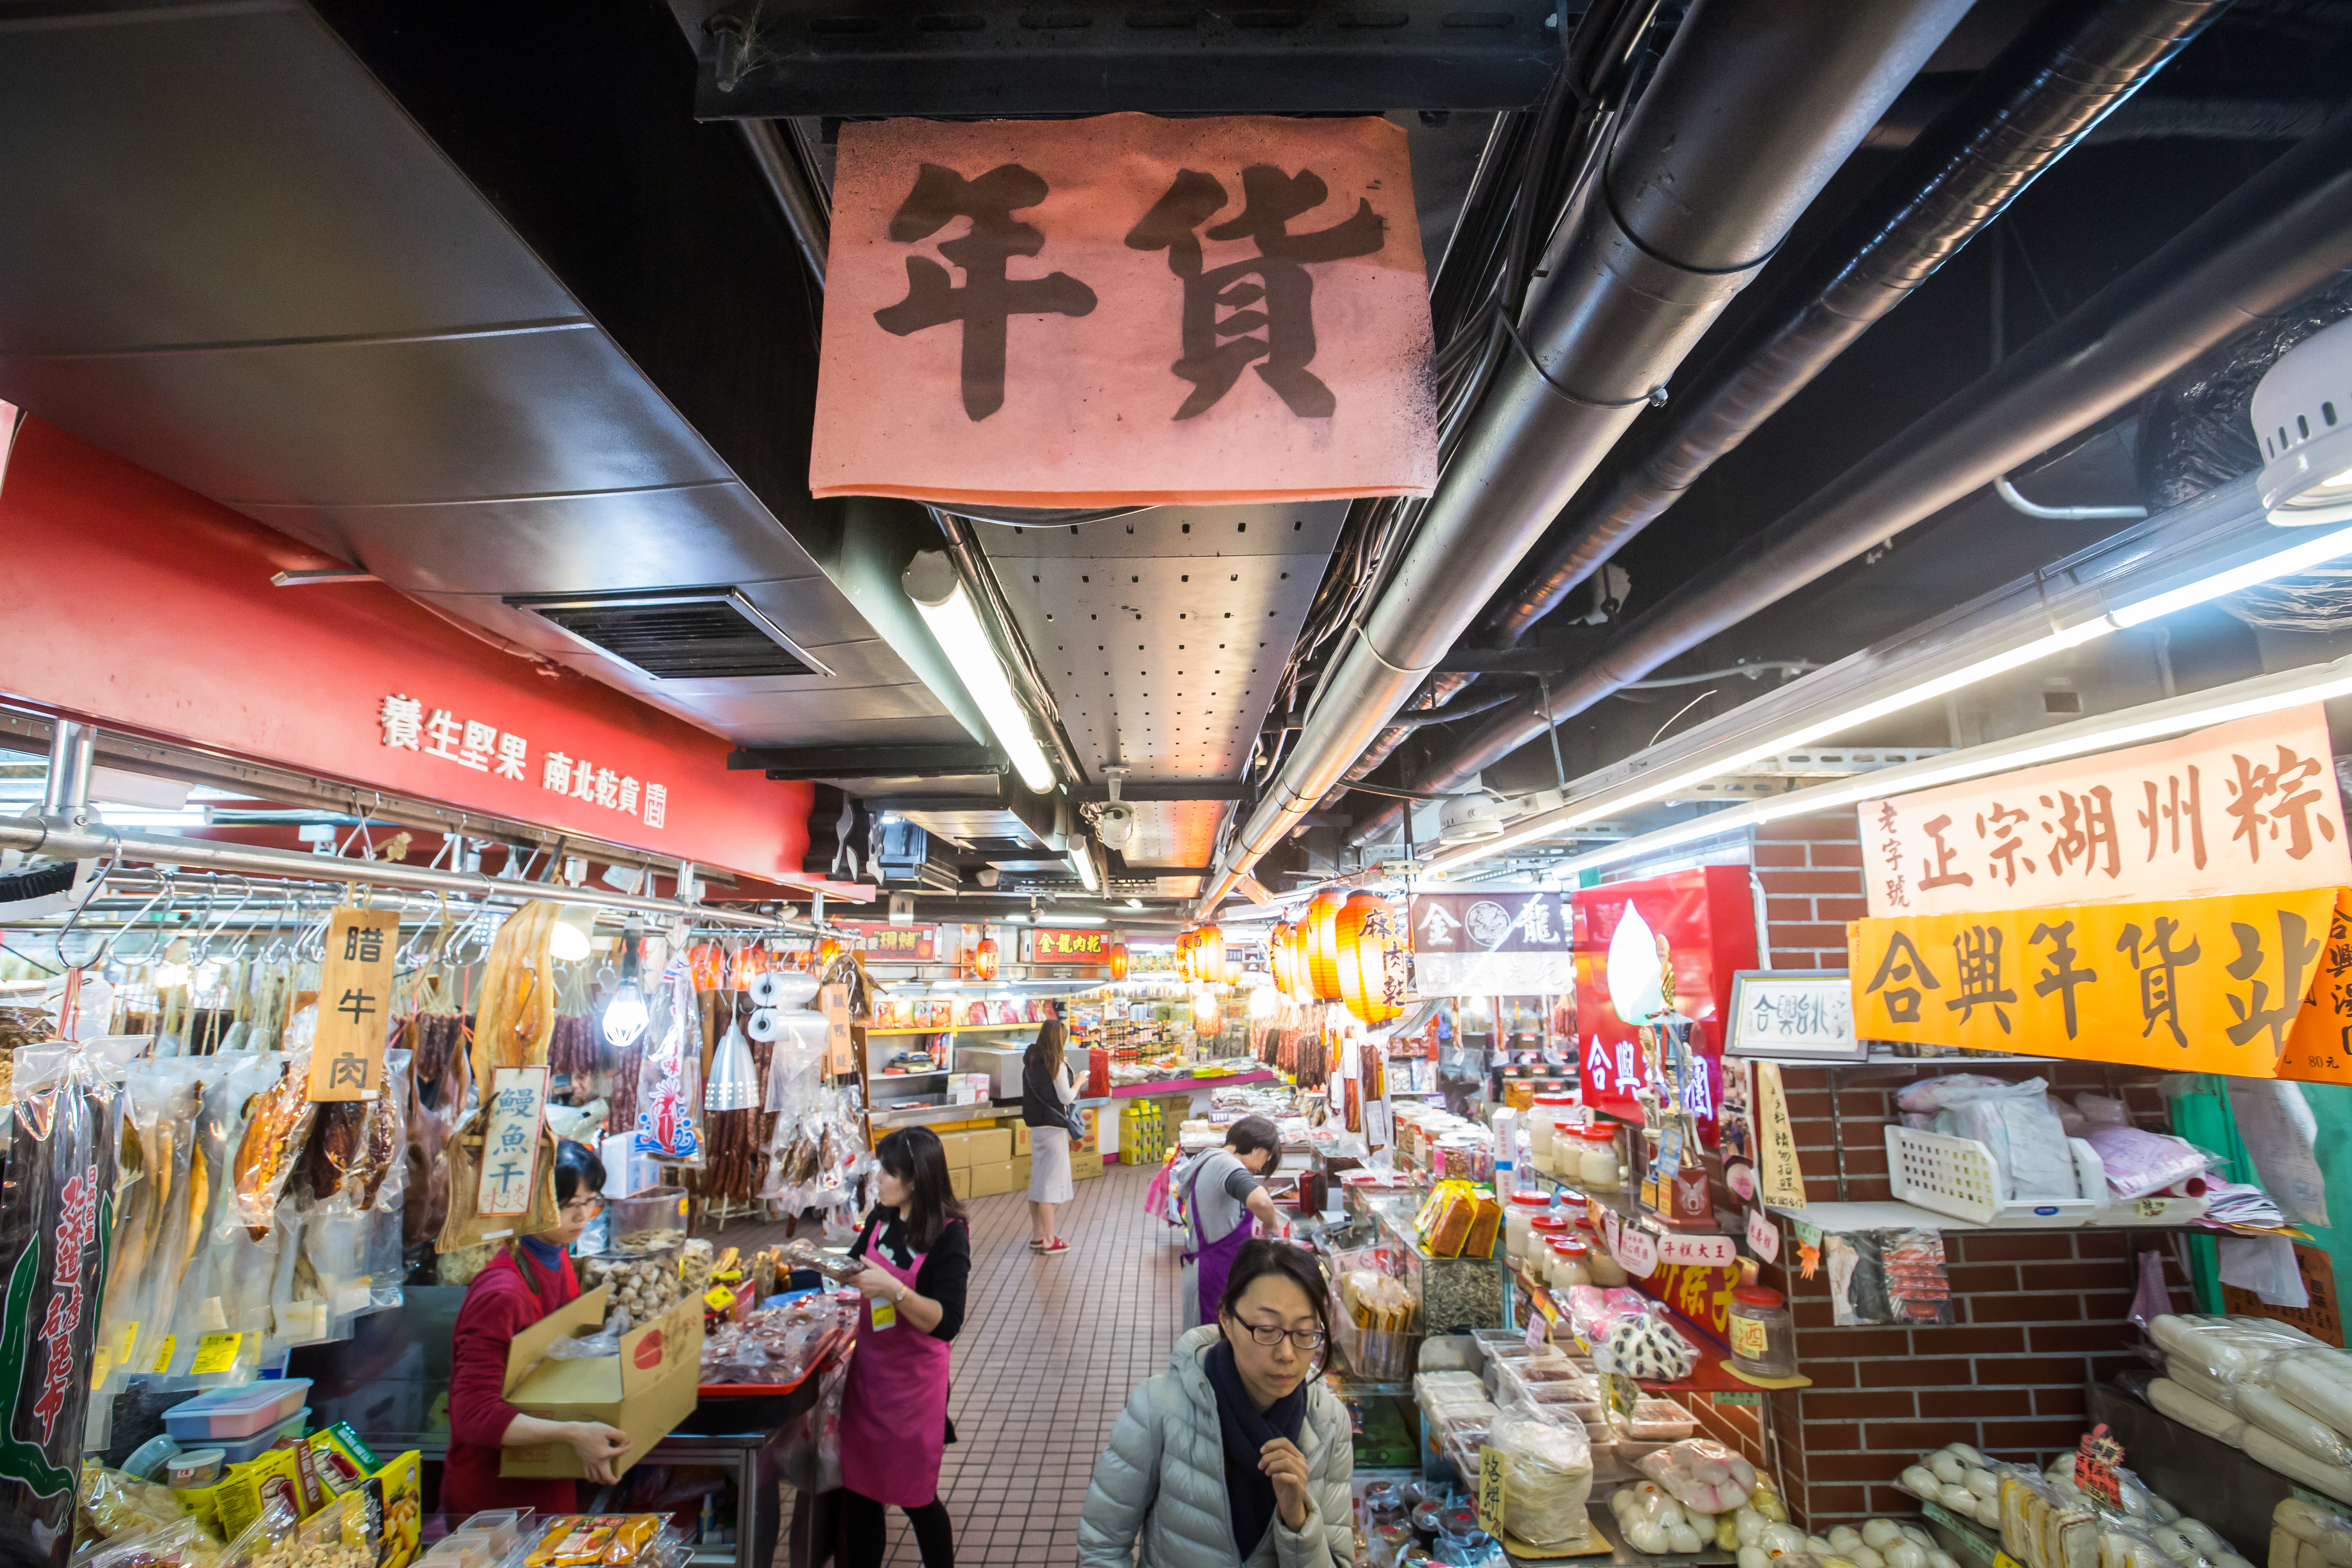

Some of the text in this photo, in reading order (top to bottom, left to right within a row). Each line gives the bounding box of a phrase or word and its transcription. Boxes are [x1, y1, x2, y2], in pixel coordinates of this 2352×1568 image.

[873, 163, 1389, 422] 年貨
[381, 693, 528, 781] 養生堅果
[542, 752, 638, 816] 南北乾貨
[1878, 801, 1910, 907] 老字號
[1917, 744, 2335, 892] 正宗湖州粽
[1037, 932, 1102, 953] 金龍肉乾
[330, 926, 383, 1089] 腊牛肉
[2308, 1055, 2339, 1069] 80元
[489, 1088, 534, 1194] 鰻魚干
